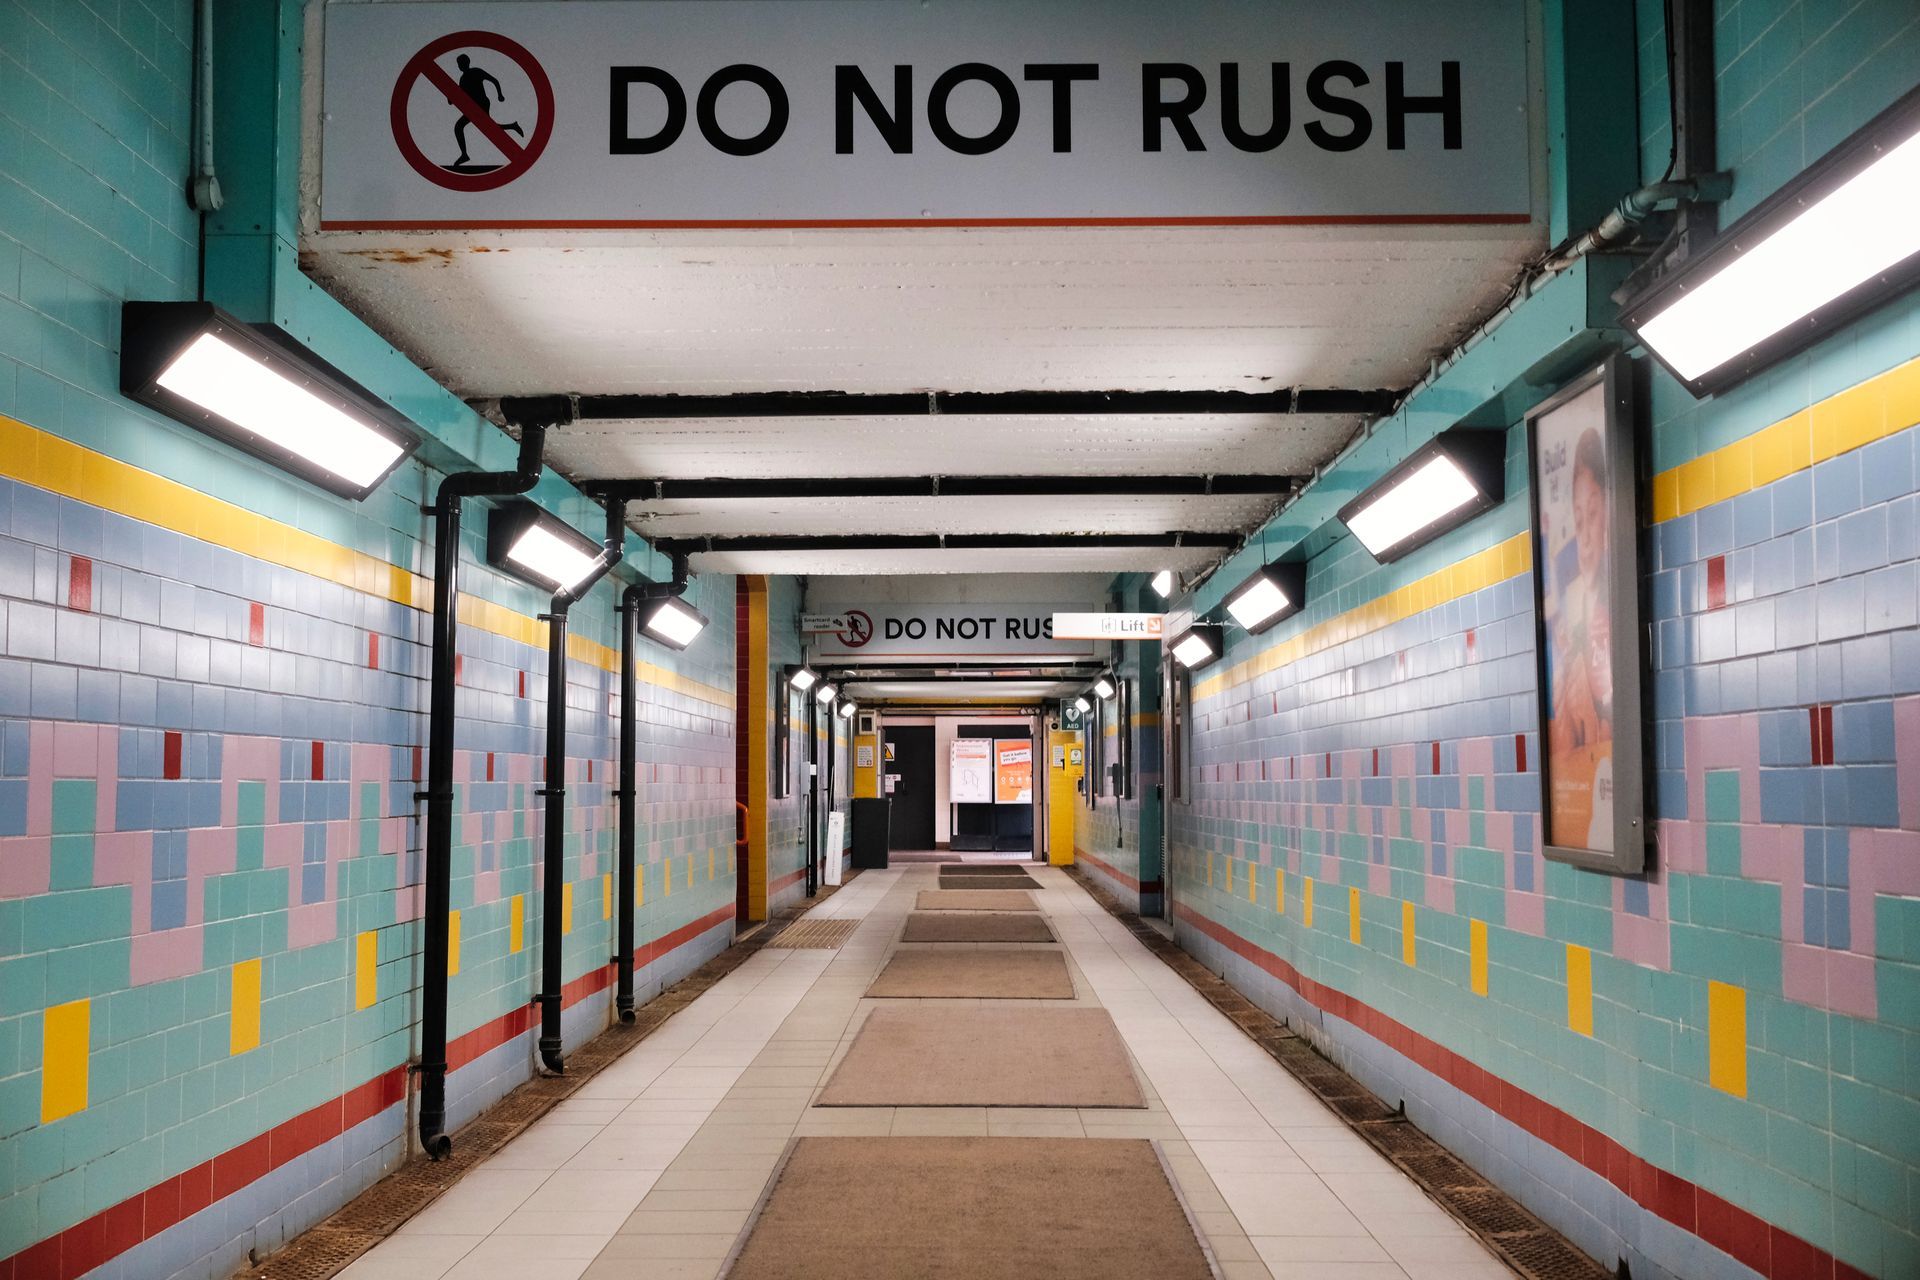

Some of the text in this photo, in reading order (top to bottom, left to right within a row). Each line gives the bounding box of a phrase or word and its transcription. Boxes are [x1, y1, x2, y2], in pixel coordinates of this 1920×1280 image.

[610, 59, 1462, 156] DO NOT RUSH
[1545, 440, 1566, 475] Build
[885, 617, 1053, 640] DO NOT RUS
[1121, 619, 1144, 632] Lift
